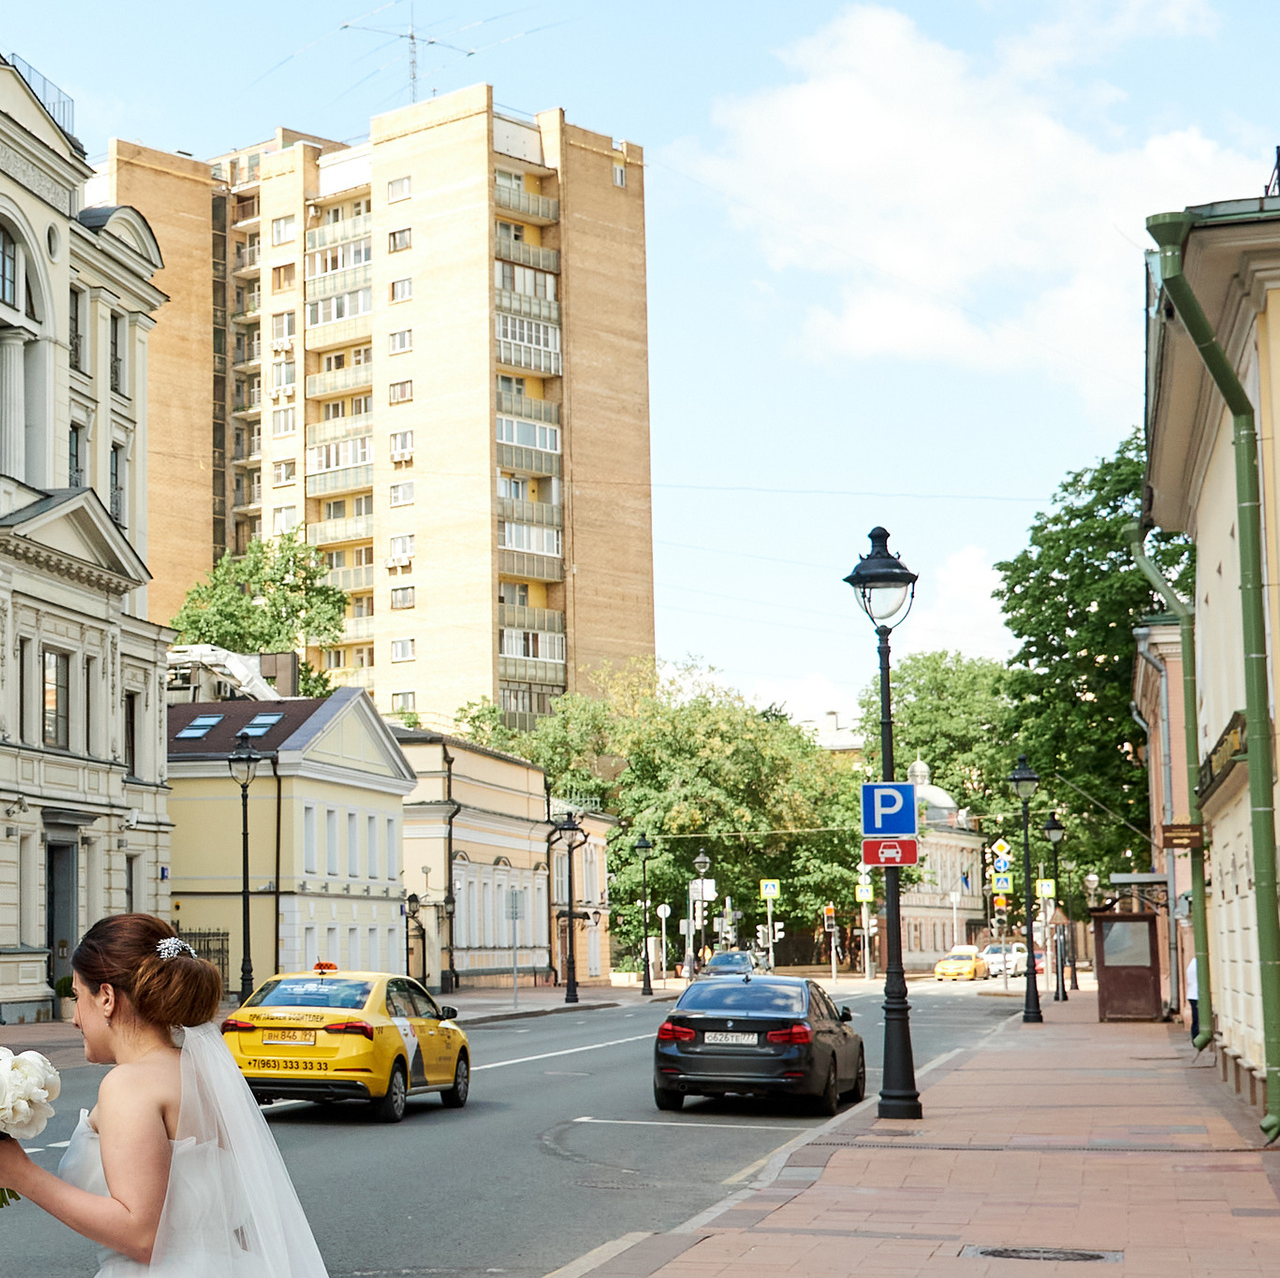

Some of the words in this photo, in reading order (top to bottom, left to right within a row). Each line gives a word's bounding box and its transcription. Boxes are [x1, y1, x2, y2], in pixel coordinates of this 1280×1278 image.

[873, 788, 904, 829] P
[248, 1059, 280, 1070] +7(963)
[283, 1060, 299, 1069] 333
[302, 1061, 314, 1070] 33
[317, 1062, 328, 1071] 33
